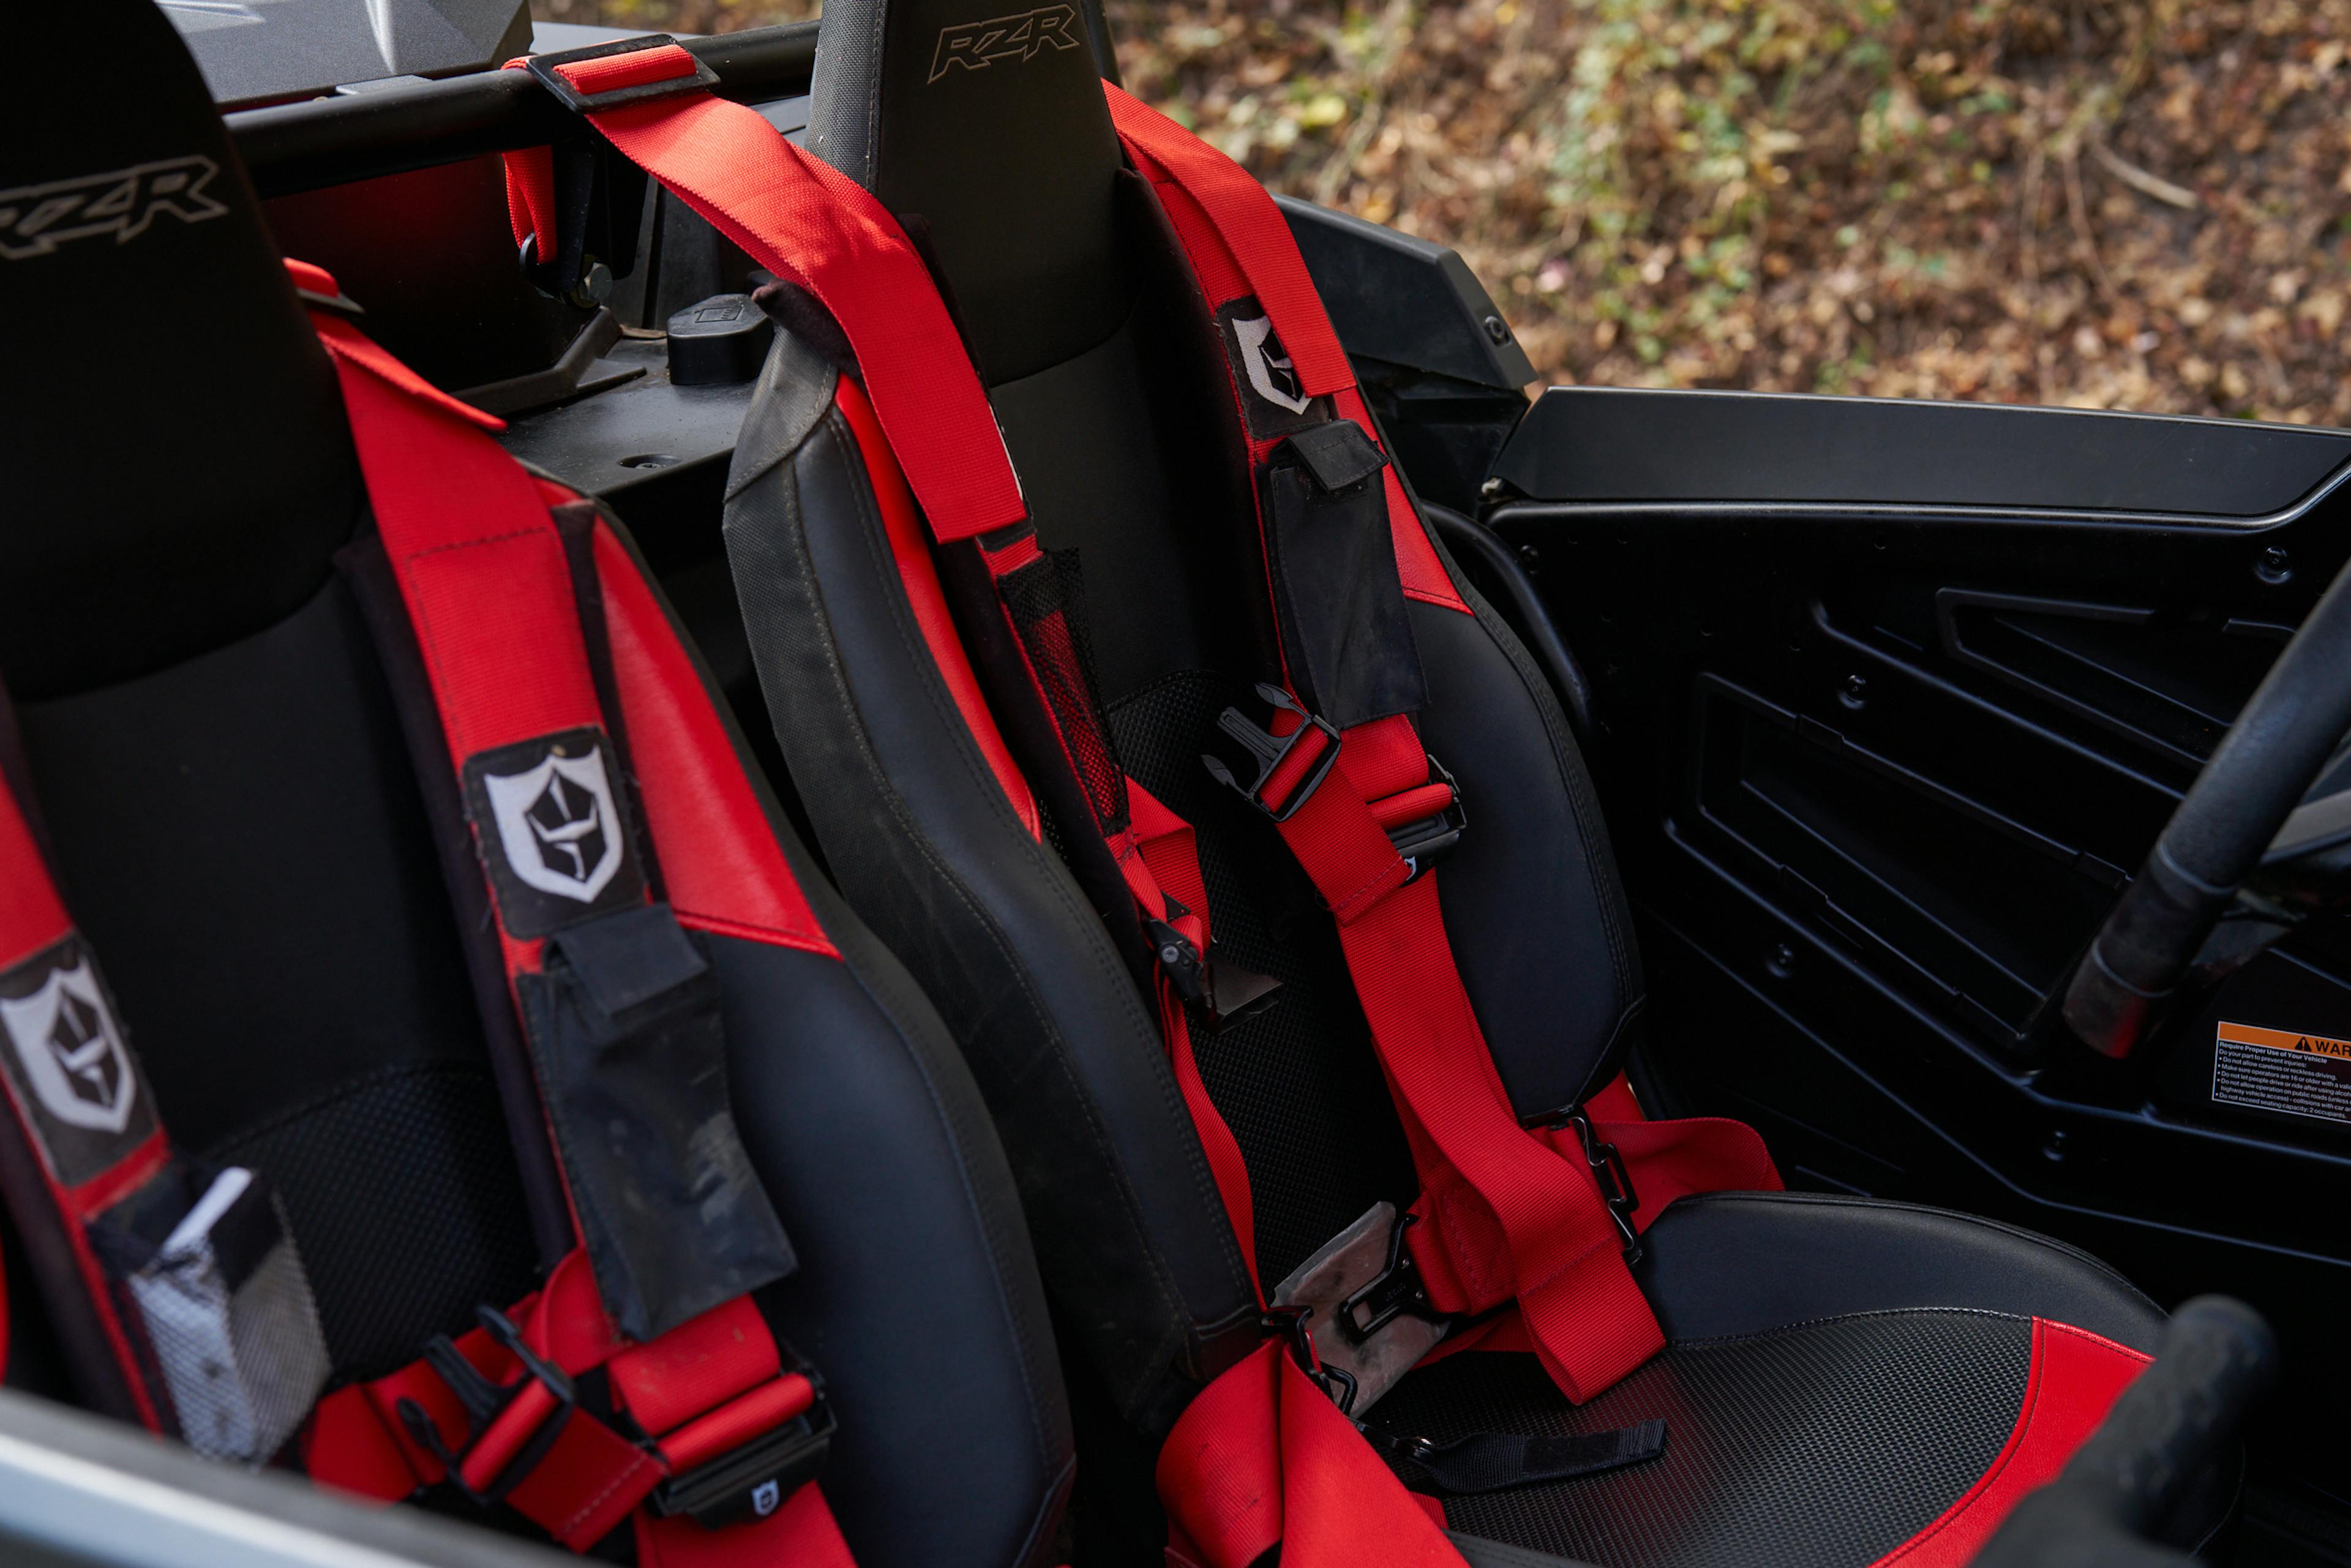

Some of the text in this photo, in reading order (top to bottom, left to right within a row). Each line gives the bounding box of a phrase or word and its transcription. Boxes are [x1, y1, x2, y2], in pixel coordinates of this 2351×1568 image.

[927, 4, 1080, 84] RZR
[2220, 1041, 2244, 1050] Require
[2303, 1055, 2327, 1063] Vehicle
[2251, 1070, 2280, 1078] operators
[2256, 1085, 2283, 1093] operation
